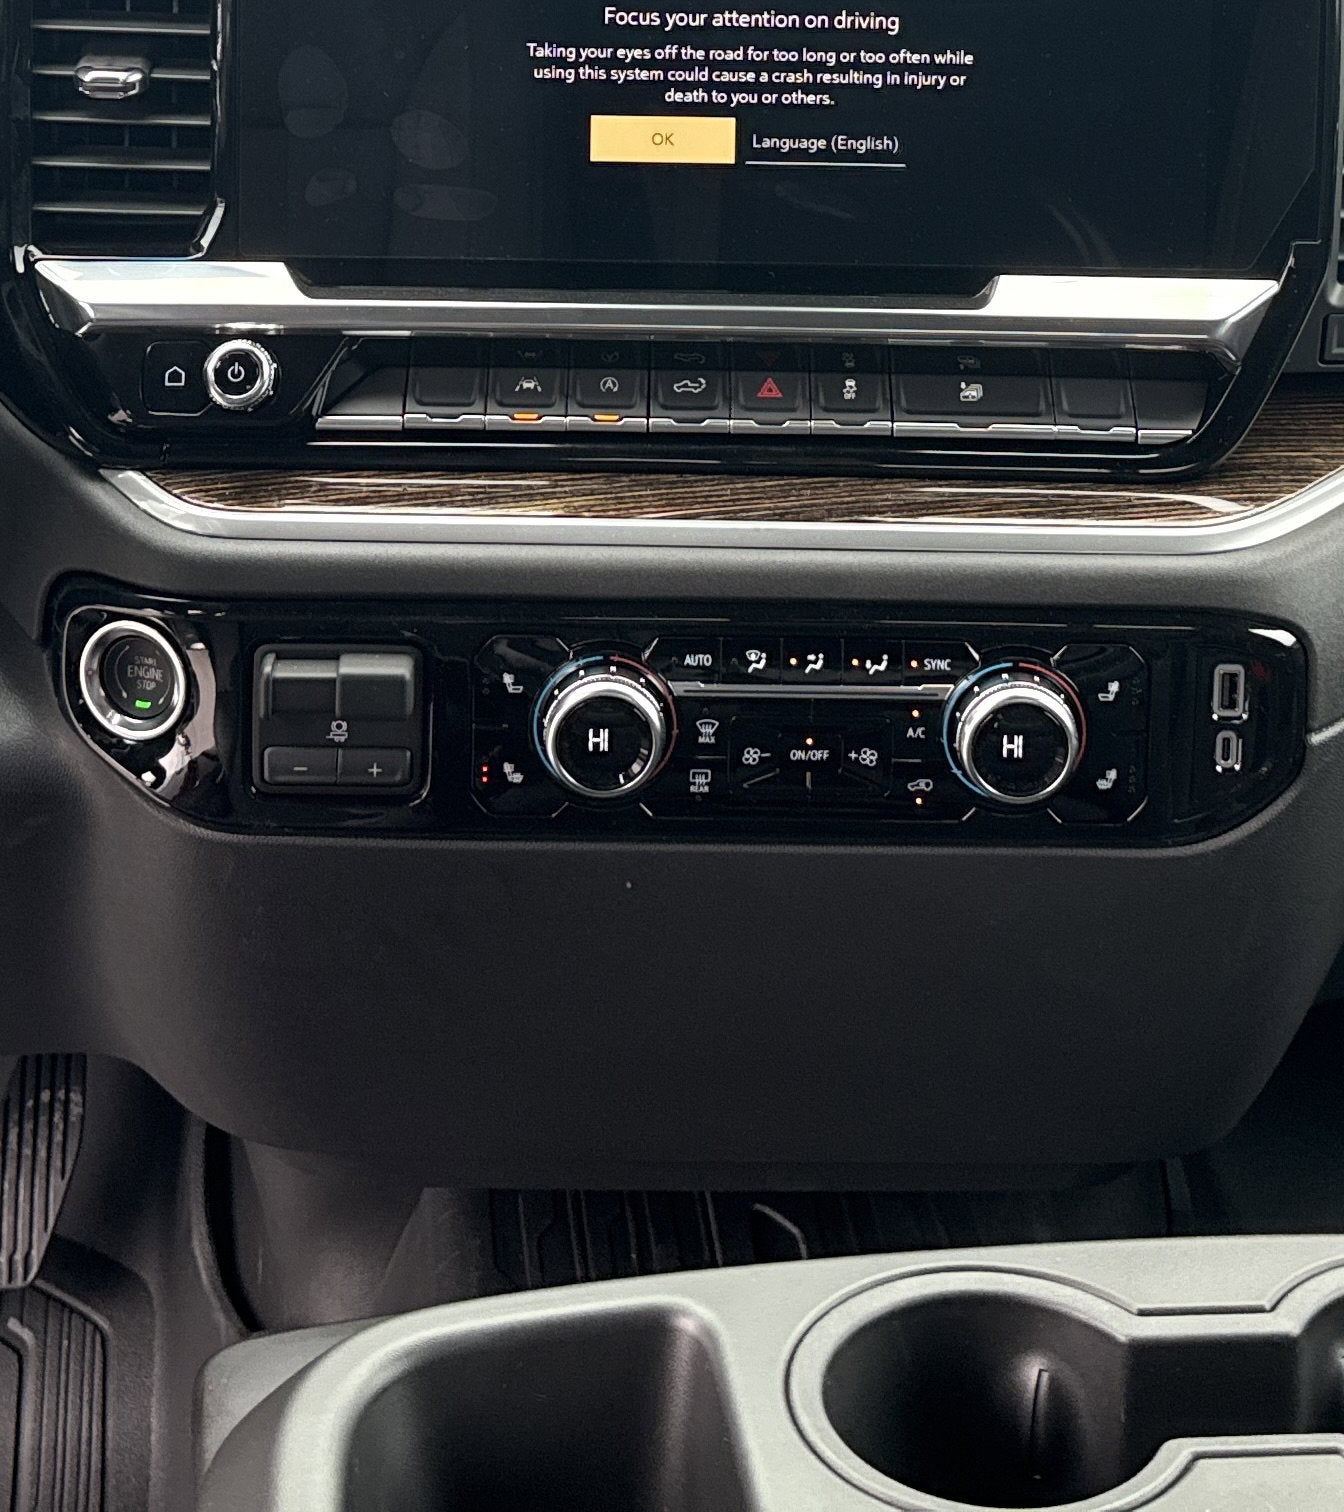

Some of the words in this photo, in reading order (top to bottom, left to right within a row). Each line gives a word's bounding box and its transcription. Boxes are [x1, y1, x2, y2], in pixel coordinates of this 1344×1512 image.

[604, 6, 660, 25] Focus
[664, 12, 707, 31] your
[711, 9, 800, 29] attention
[804, 14, 829, 29] on
[833, 9, 900, 35] driving
[526, 42, 576, 62] Taking
[579, 47, 613, 62] your
[616, 48, 651, 63] eyes
[654, 45, 679, 60] off
[681, 45, 705, 60] the
[709, 46, 744, 61] road
[747, 46, 769, 62] for
[772, 48, 799, 62] too
[802, 47, 836, 66] long
[839, 51, 856, 63] or
[860, 49, 885, 64] too
[888, 48, 931, 64] often
[934, 49, 974, 65] while
[533, 65, 575, 83] using
[578, 65, 607, 80] this
[610, 68, 664, 84] system
[667, 66, 709, 81] could
[712, 70, 756, 82] cause
[759, 71, 768, 83] a
[772, 69, 813, 84] crash
[816, 69, 883, 88] resulting
[886, 71, 900, 85] in
[904, 72, 947, 89] injury
[949, 74, 967, 86] or
[664, 88, 708, 103] death
[711, 89, 727, 103] to
[730, 92, 758, 107] you
[761, 92, 778, 105] or
[781, 89, 835, 105] others.
[651, 132, 675, 147] OK
[752, 134, 827, 152] Language
[830, 134, 900, 154] (English)
[684, 653, 712, 667] AUTO
[923, 658, 952, 671] SYNC
[127, 664, 164, 682] ENGINE
[136, 679, 157, 691] STOP
[588, 727, 609, 752] HI
[906, 726, 926, 738] A/C
[790, 748, 830, 761] ON/OFF
[1002, 734, 1024, 759] HI
